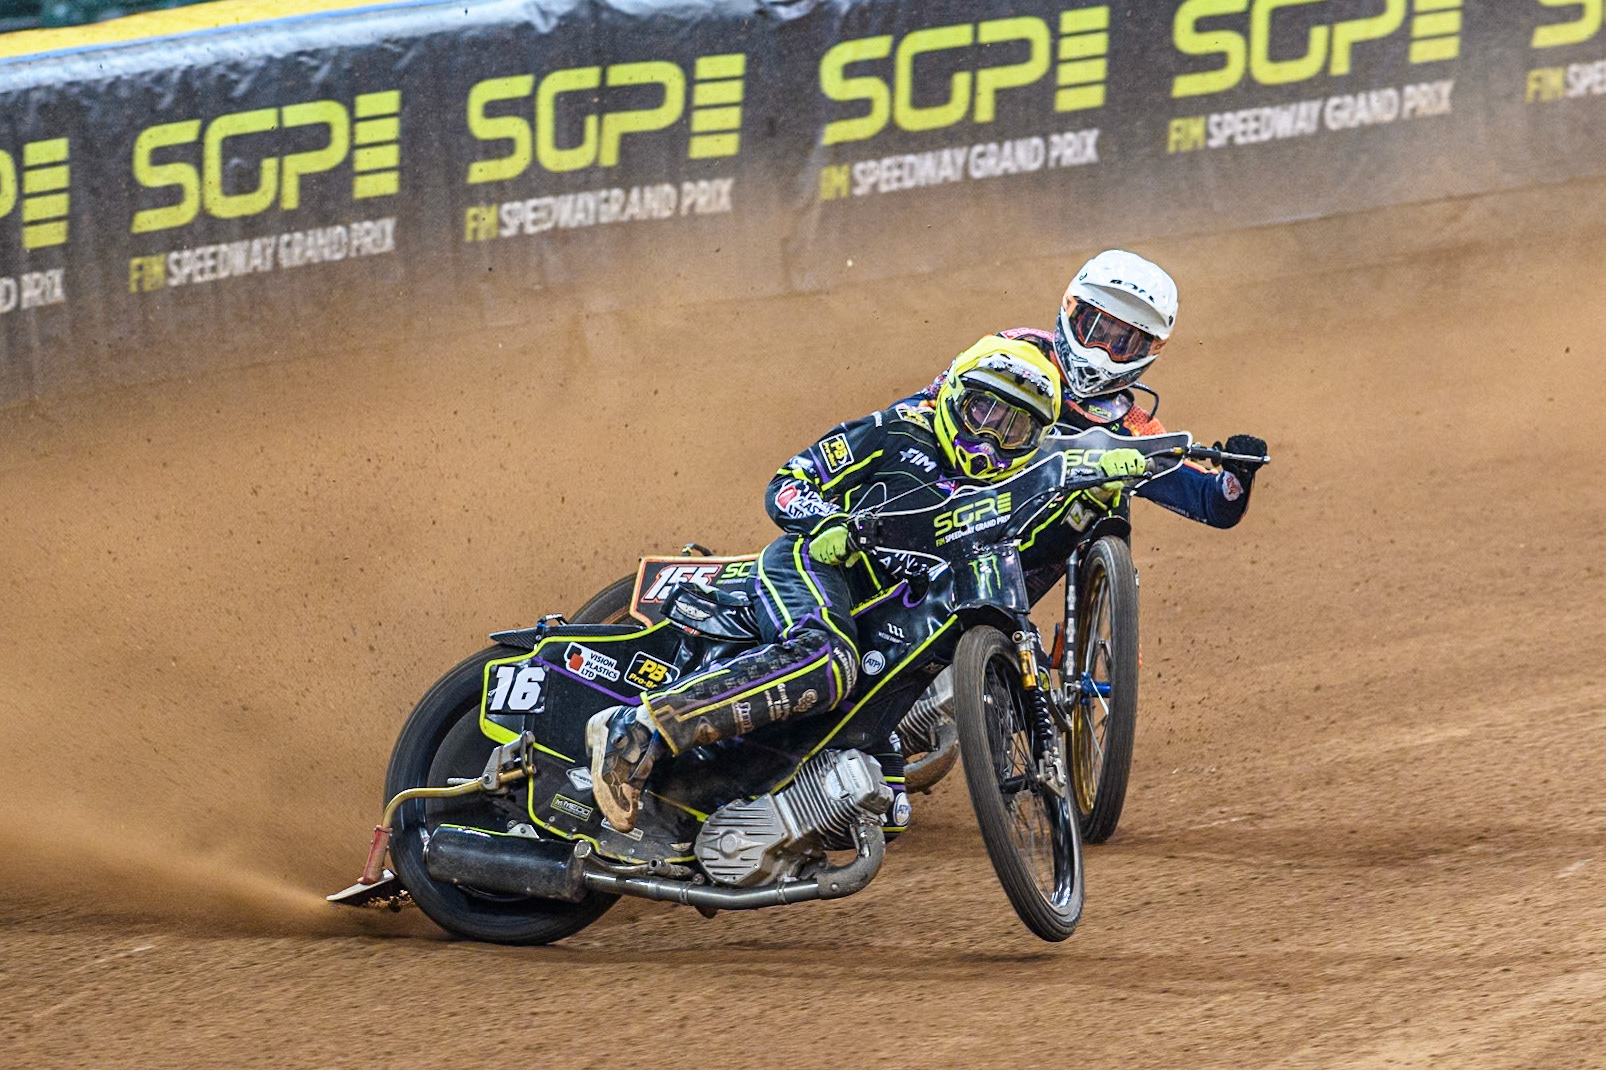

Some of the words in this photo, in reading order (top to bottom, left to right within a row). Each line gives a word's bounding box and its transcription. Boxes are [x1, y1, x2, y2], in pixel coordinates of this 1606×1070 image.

[1207, 99, 1323, 149] SPEEDWAY
[1324, 88, 1400, 131] GRAND
[1402, 79, 1454, 120] PRIX
[852, 146, 968, 197] SPEEDWAY
[968, 136, 1045, 180] GRAND
[1048, 128, 1100, 168] PRIX
[680, 177, 735, 217] PRIX
[167, 235, 277, 288] SPEEDWAY
[278, 225, 349, 269] GRAND
[349, 217, 397, 258] PRIX
[975, 518, 997, 531] GRAND
[580, 668, 595, 679] LTD
[584, 660, 618, 680] PLASTICS
[590, 652, 616, 668] VISION
[638, 658, 669, 683] PB
[489, 666, 546, 712] 16
